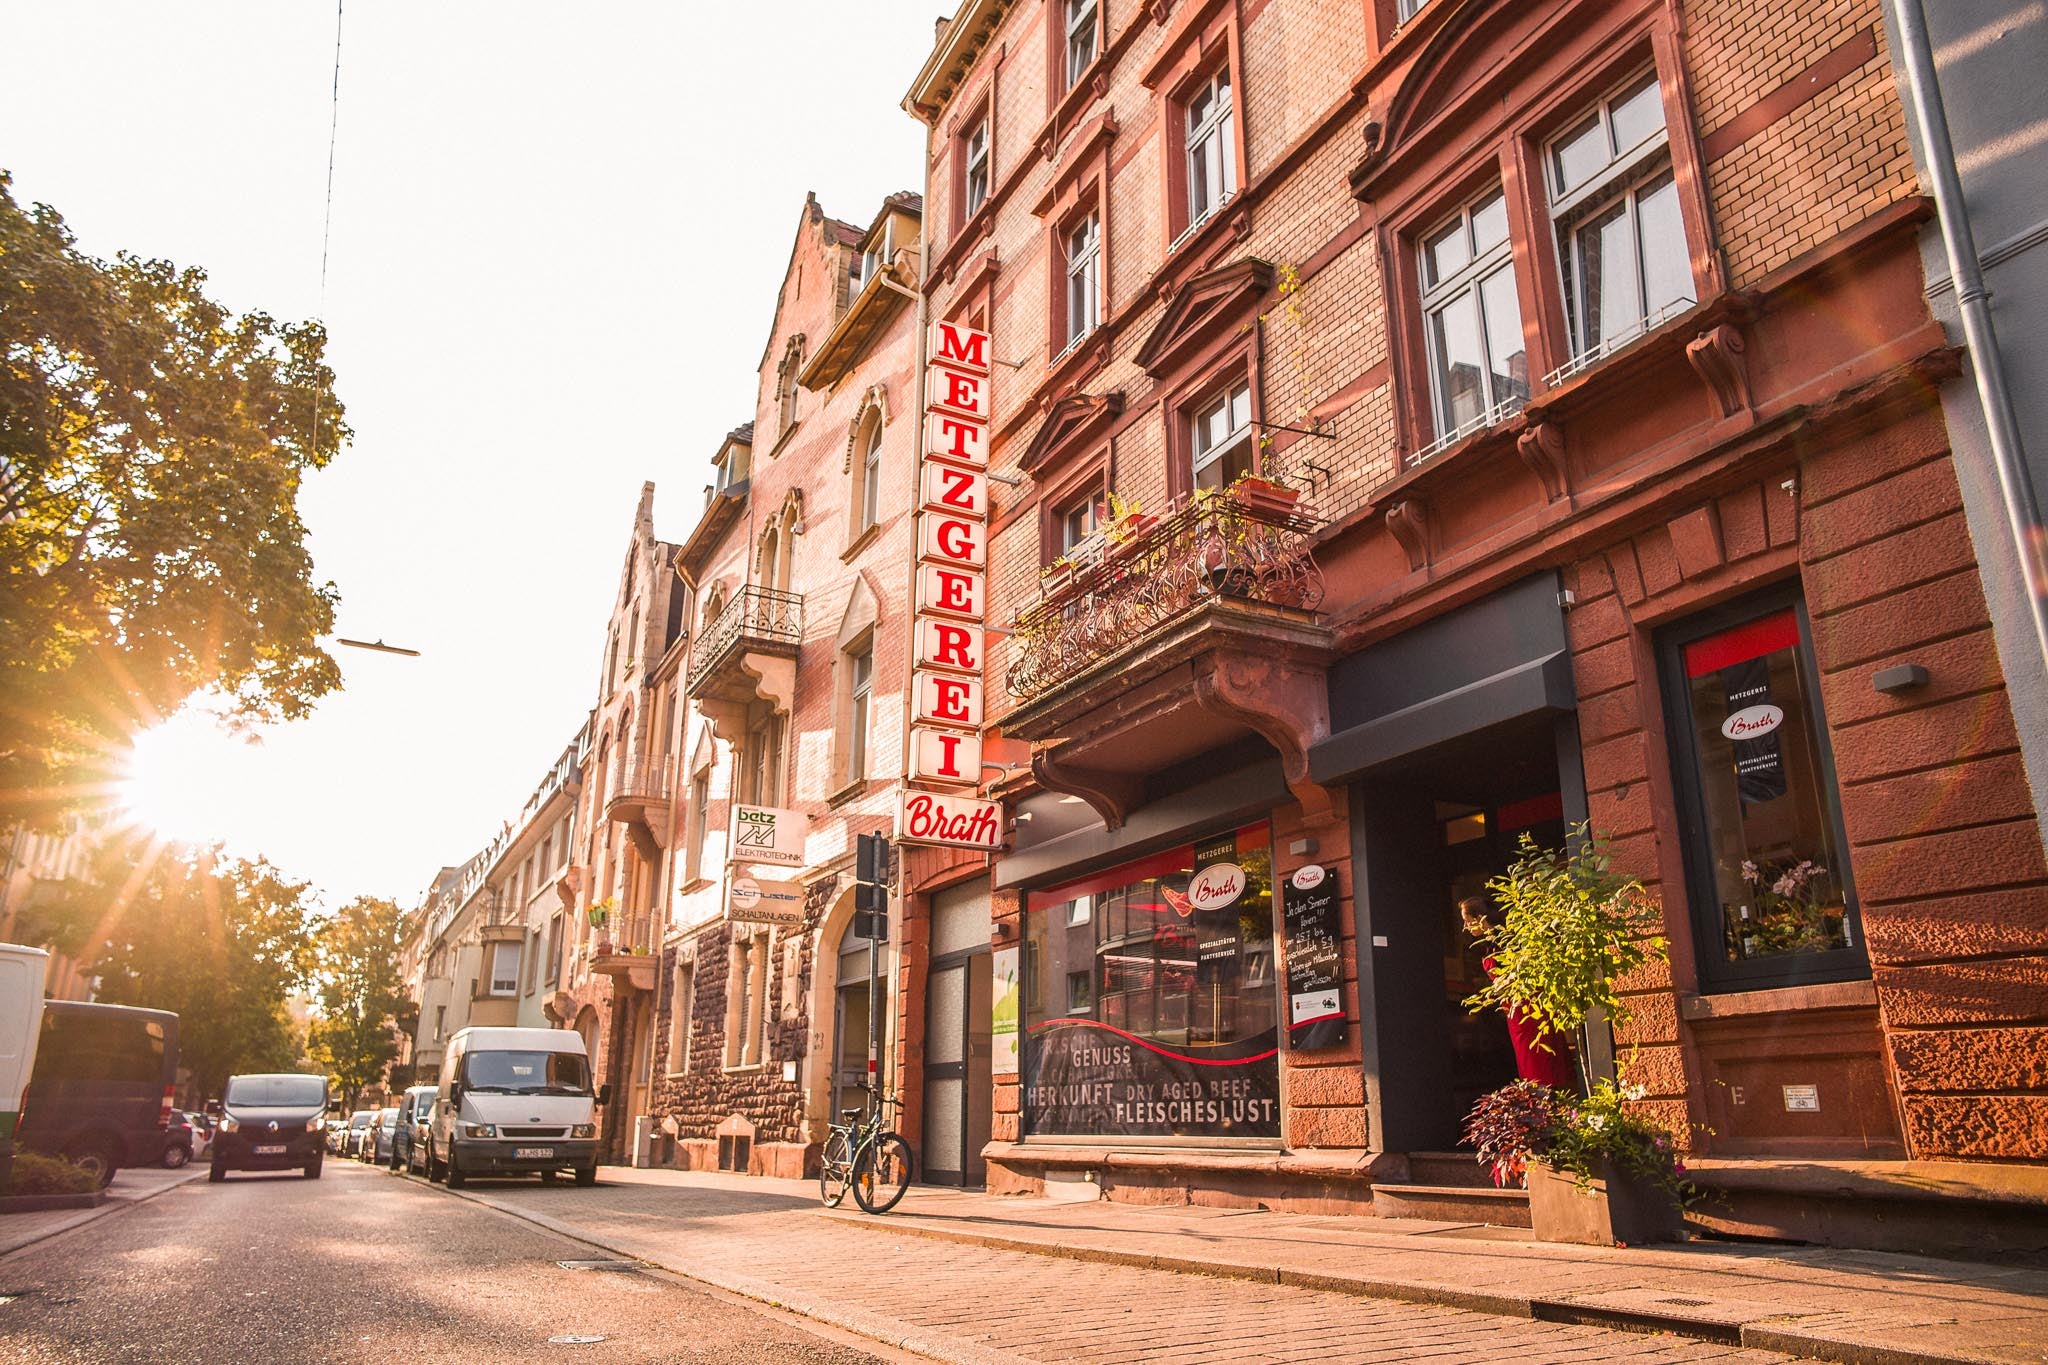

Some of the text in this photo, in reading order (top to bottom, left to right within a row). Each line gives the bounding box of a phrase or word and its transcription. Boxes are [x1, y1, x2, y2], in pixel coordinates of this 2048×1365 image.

[932, 323, 988, 778] METZGEREI
[1729, 685, 1767, 701] METZGEREI
[1729, 712, 1775, 735] Brath
[1740, 761, 1777, 774] PARTYSERVICE
[738, 807, 776, 825] betz
[906, 795, 998, 846] Brath
[735, 848, 802, 862] ELEKTROTECHNIK
[1197, 844, 1233, 861] METZGEREI
[1296, 871, 1320, 886] Brath
[732, 888, 802, 901] Schuster
[1195, 874, 1238, 902] Brath
[731, 908, 800, 921] SCHALTANLAGEN
[1199, 937, 1236, 950] SPEZIALITÄTEN
[1200, 949, 1236, 961] PARTYSERVICE
[1072, 1045, 1131, 1068] GENUSS
[1027, 1082, 1114, 1107] HERKUNFT
[1126, 1078, 1251, 1101] DRY AGED BEEF
[1116, 1098, 1273, 1123] FLEISCHESLUST
